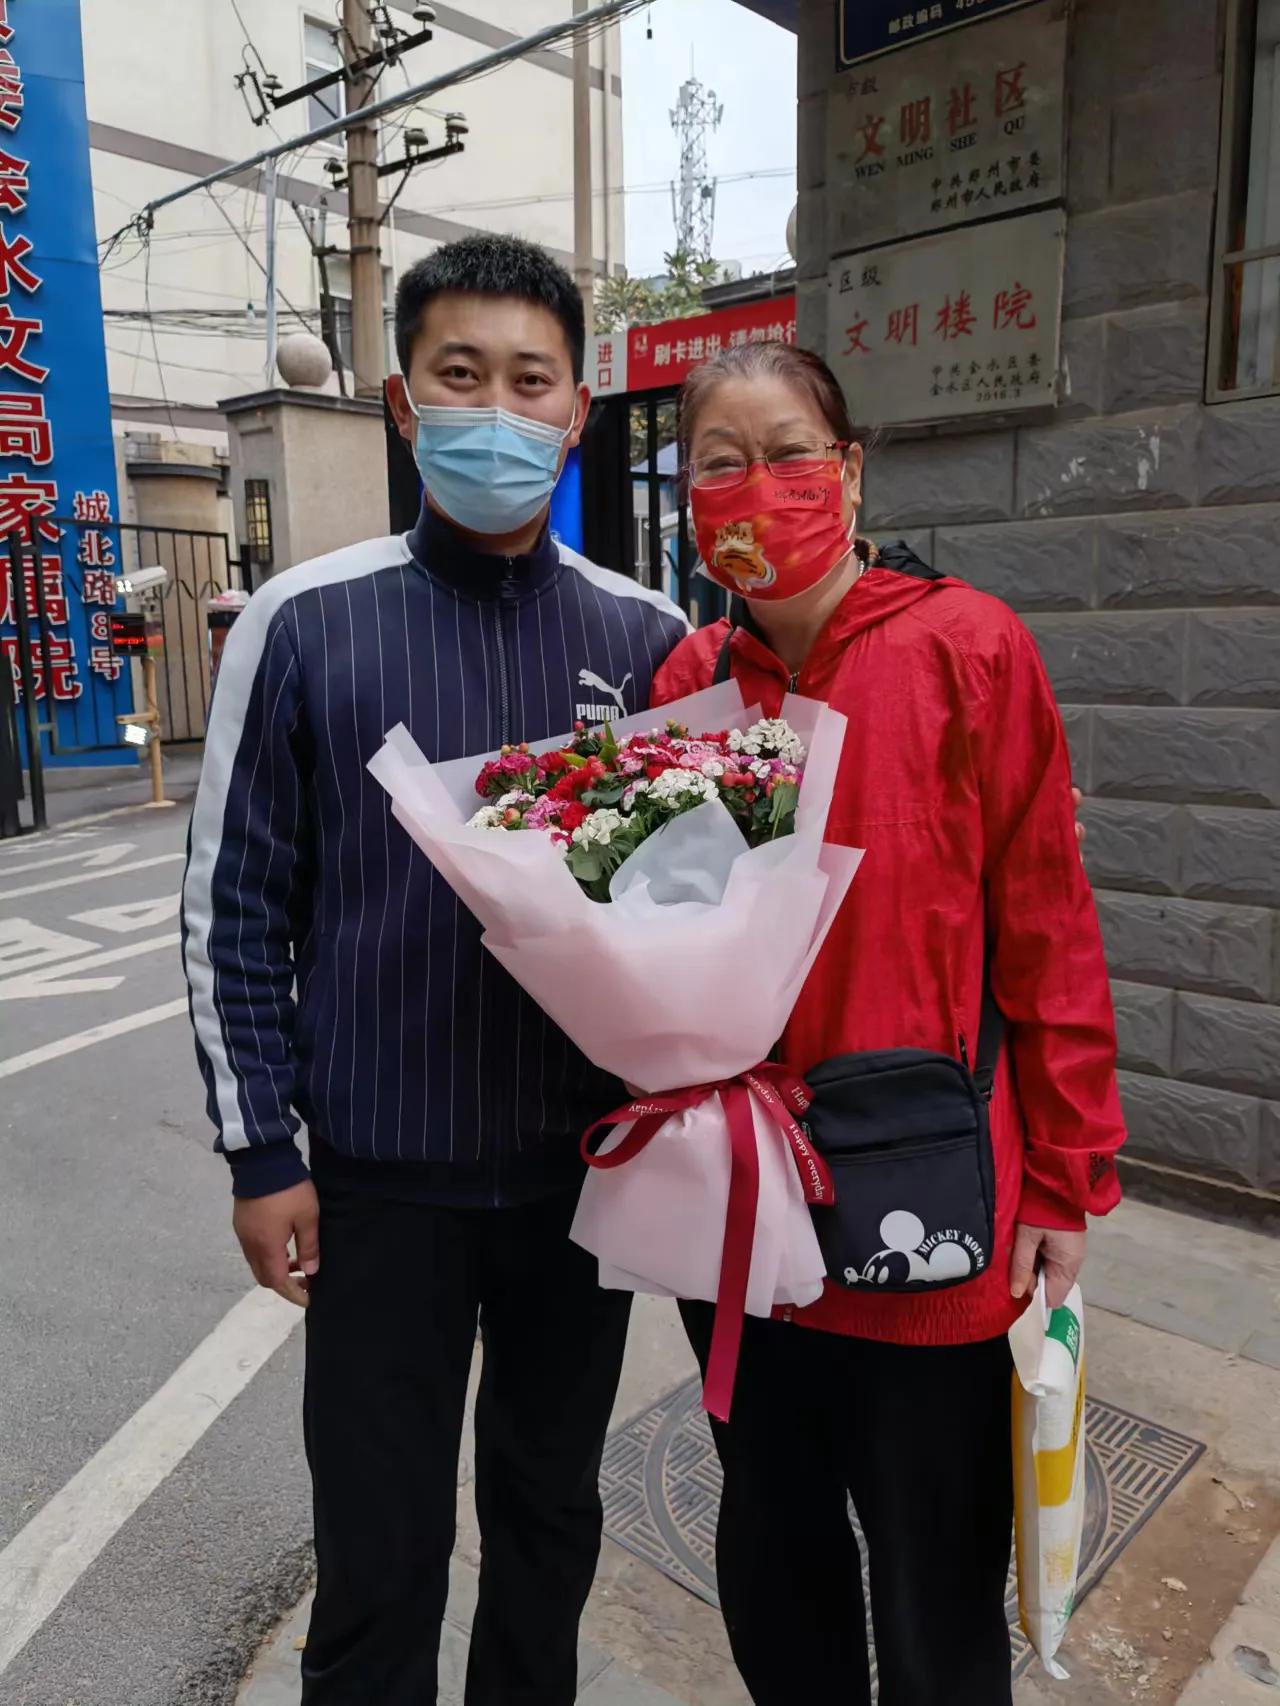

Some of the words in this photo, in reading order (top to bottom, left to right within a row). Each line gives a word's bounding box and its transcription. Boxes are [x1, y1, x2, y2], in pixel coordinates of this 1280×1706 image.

[854, 62, 1027, 163] 文明社区
[855, 163, 885, 179] WEN
[896, 148, 933, 168] MING
[950, 132, 977, 152] SHE
[1003, 117, 1025, 135] QU
[842, 281, 1036, 356] 文明楼院
[597, 343, 612, 389] 进口
[653, 334, 722, 367] 刷卡进出
[74, 489, 124, 682] 城北路8号
[575, 703, 620, 721] PUMA
[788, 1123, 810, 1157] Happy
[807, 1158, 825, 1201] everyday
[917, 1229, 961, 1257] MICKEY
[961, 1234, 985, 1271] MOUSE
